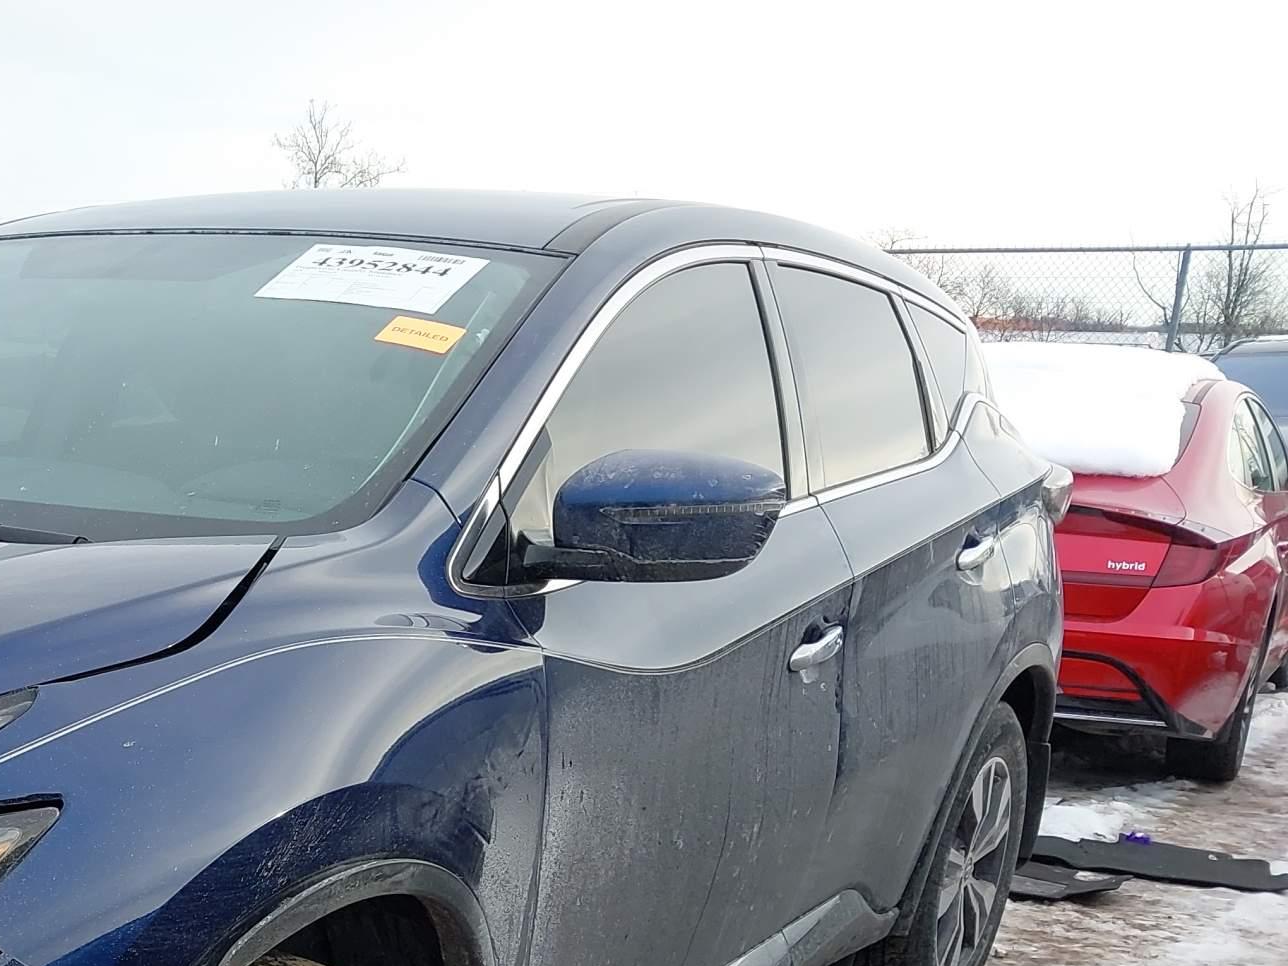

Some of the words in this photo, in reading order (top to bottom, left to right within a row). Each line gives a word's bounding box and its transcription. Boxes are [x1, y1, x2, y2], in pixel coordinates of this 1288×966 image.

[312, 255, 452, 277] 43952844
[391, 324, 449, 343] DETAILED
[1107, 560, 1146, 571] hybrid
